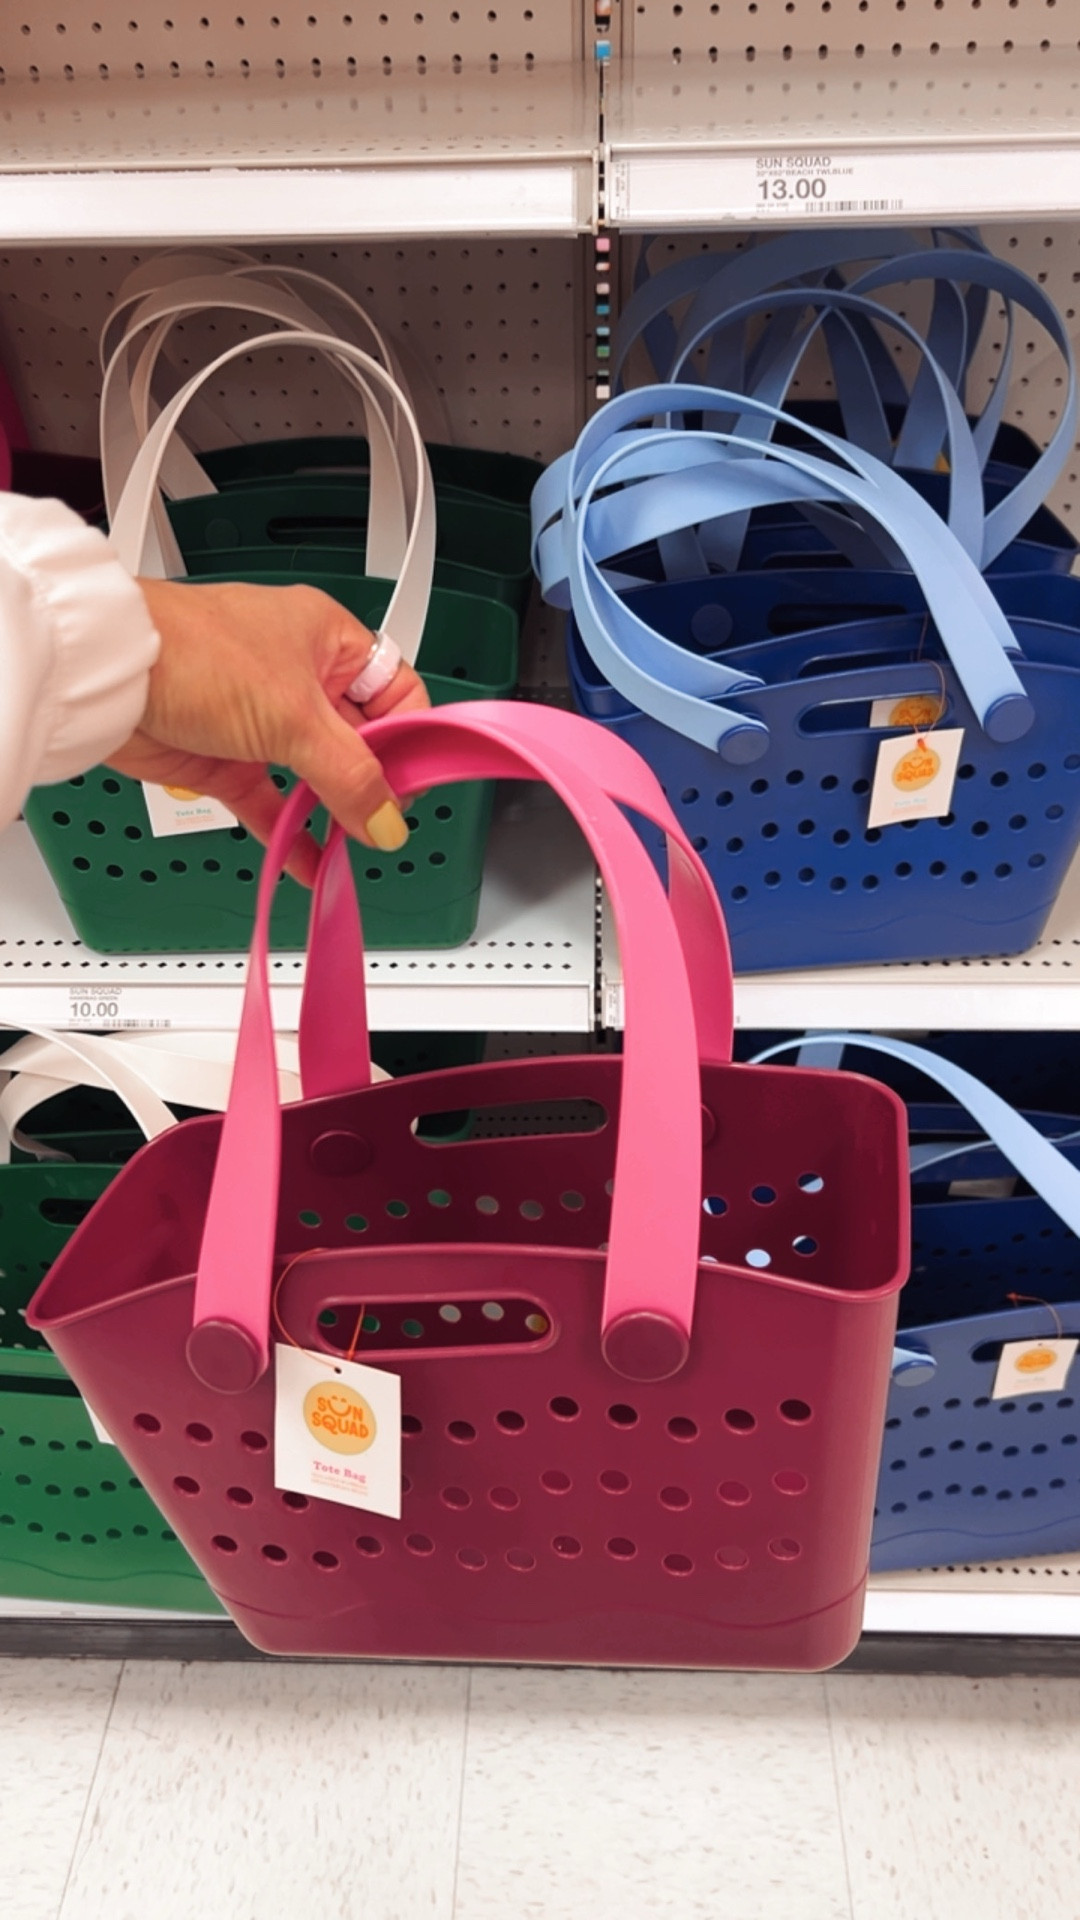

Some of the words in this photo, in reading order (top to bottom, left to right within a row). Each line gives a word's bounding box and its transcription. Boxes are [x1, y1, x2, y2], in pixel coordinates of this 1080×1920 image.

[756, 158, 782, 169] SUN
[786, 156, 831, 168] SQUAD
[758, 178, 826, 200] 13.00
[69, 987, 88, 996] SUN
[91, 987, 122, 996] SQUAD
[70, 1002, 119, 1017] 10.00
[317, 1395, 364, 1422] SUN
[312, 1411, 369, 1439] SQUAD
[313, 1460, 341, 1475] Tote
[344, 1467, 366, 1484] Bag
